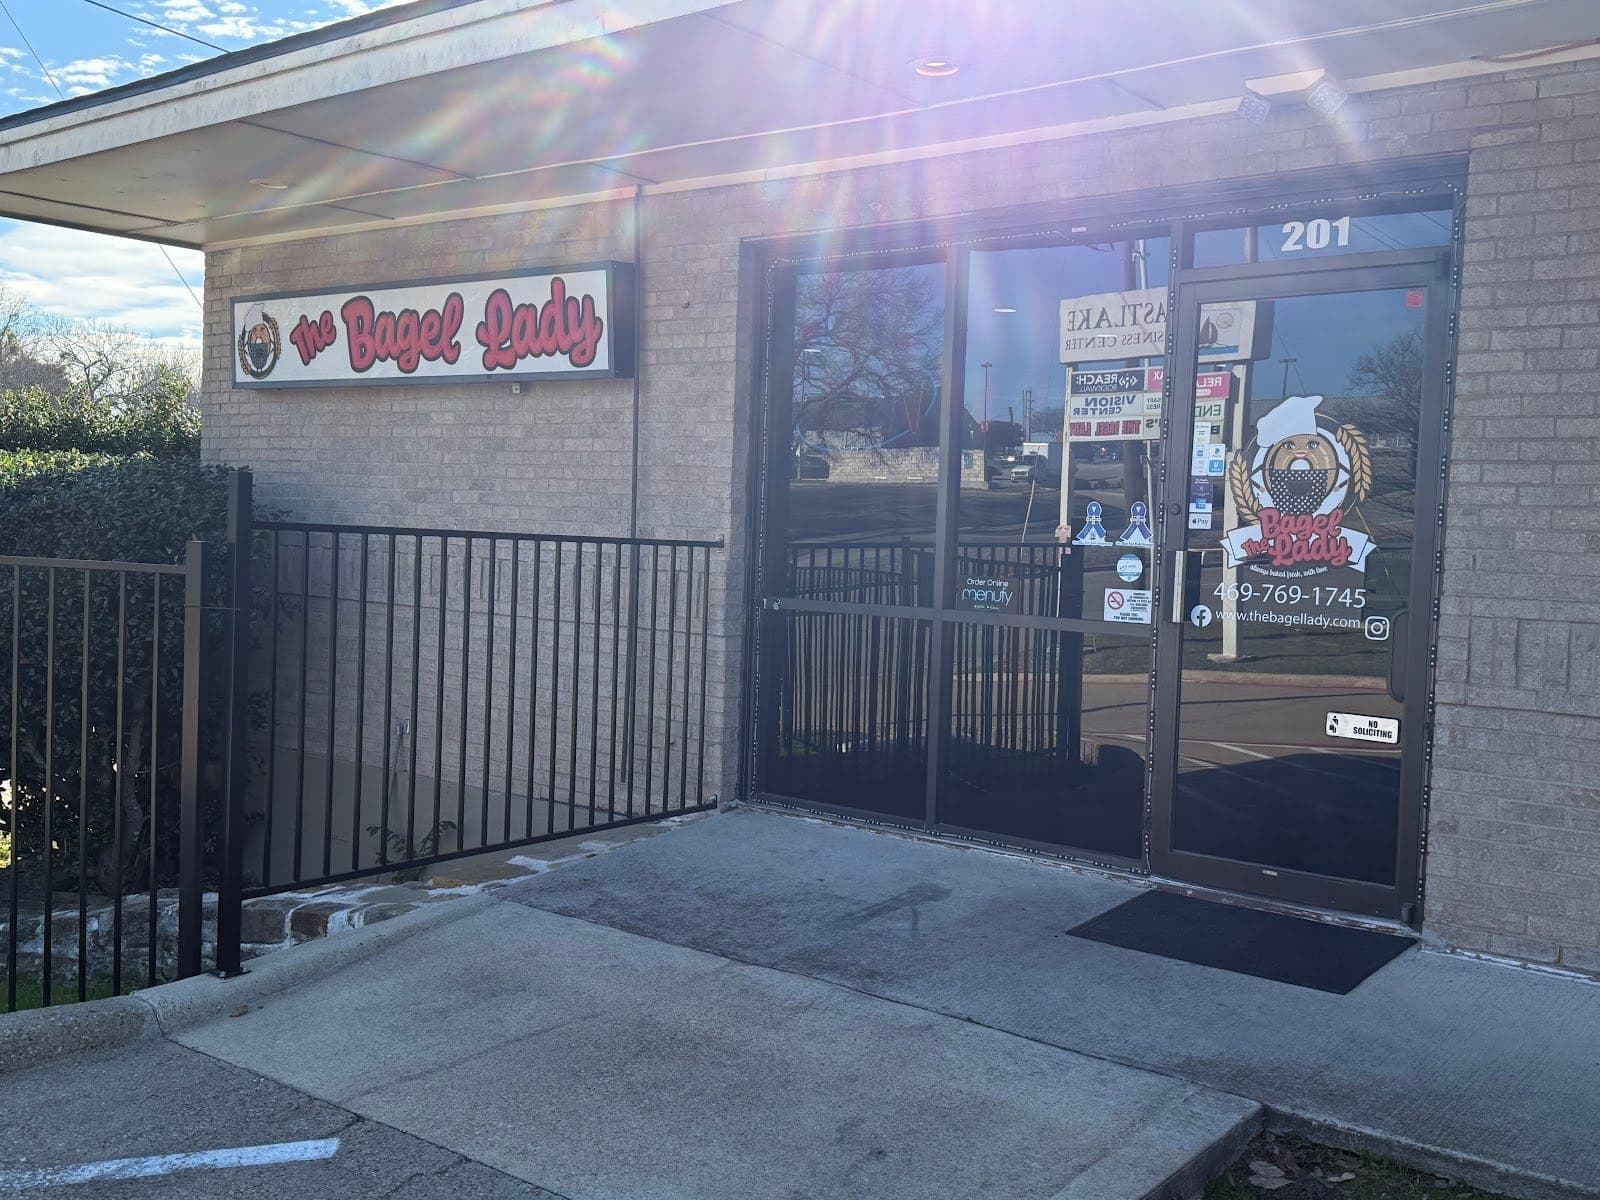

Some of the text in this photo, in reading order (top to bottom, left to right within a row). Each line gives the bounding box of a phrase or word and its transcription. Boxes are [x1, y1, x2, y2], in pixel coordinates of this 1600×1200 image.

[1281, 216, 1350, 251] 201
[289, 276, 604, 374] The Bagel Lady
[1258, 507, 1344, 539] Bagel
[1268, 531, 1352, 566] Lady
[967, 577, 1009, 587] Order Online
[1213, 582, 1367, 609] 469-769-1745
[1215, 610, 1361, 630] www.thebagellady.com
[1353, 727, 1393, 739] SOLICITING
[1368, 720, 1378, 729] NO
